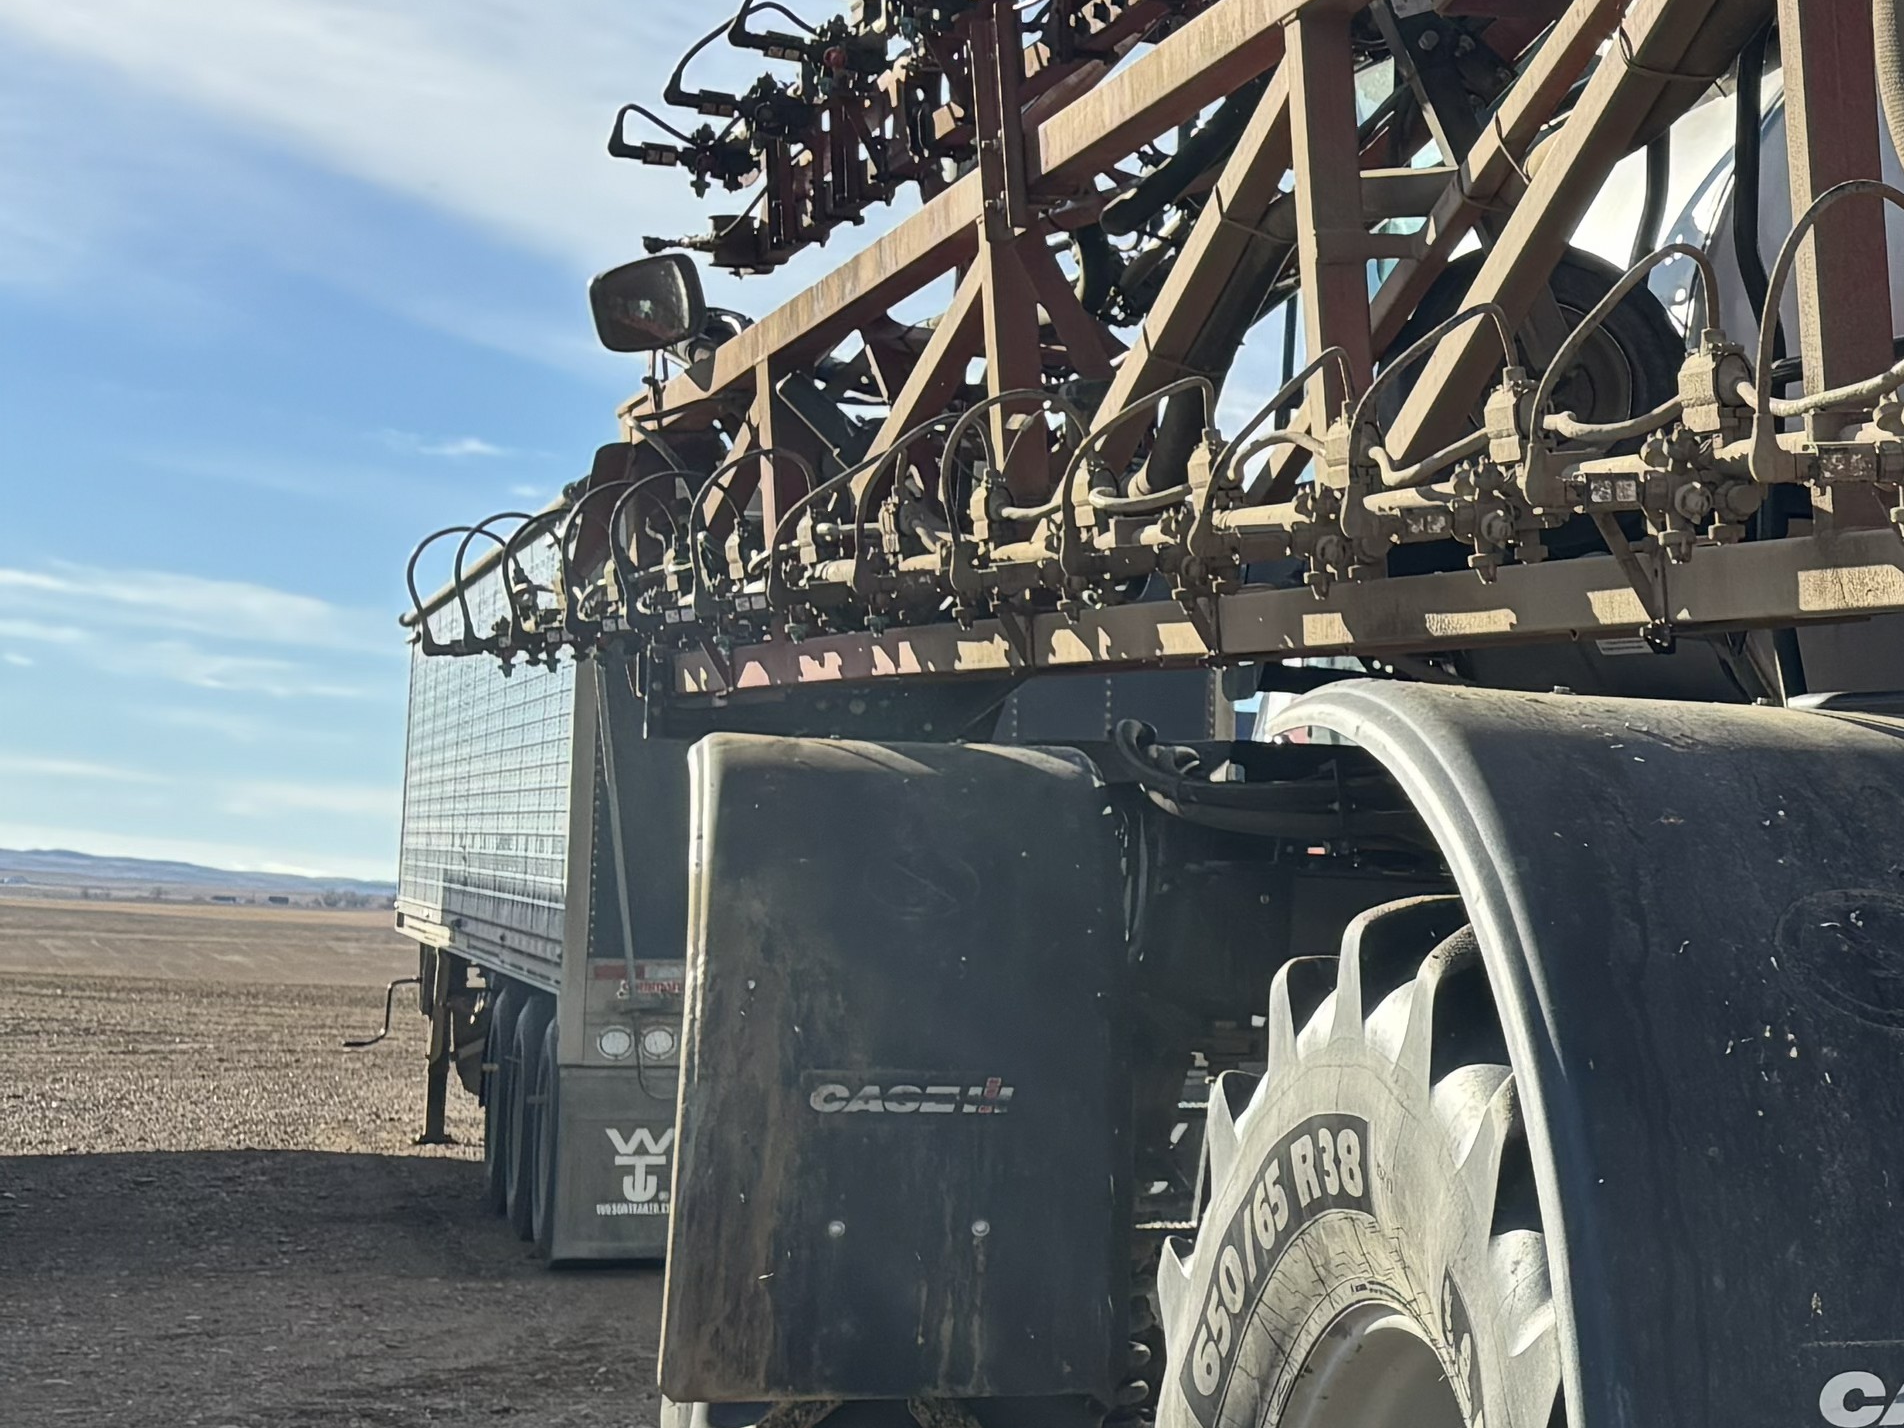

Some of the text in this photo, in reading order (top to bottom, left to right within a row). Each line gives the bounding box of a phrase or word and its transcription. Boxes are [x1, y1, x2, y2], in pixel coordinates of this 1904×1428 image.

[810, 1084, 961, 1113] CASE
[1193, 1127, 1364, 1396] 650/65 R38
